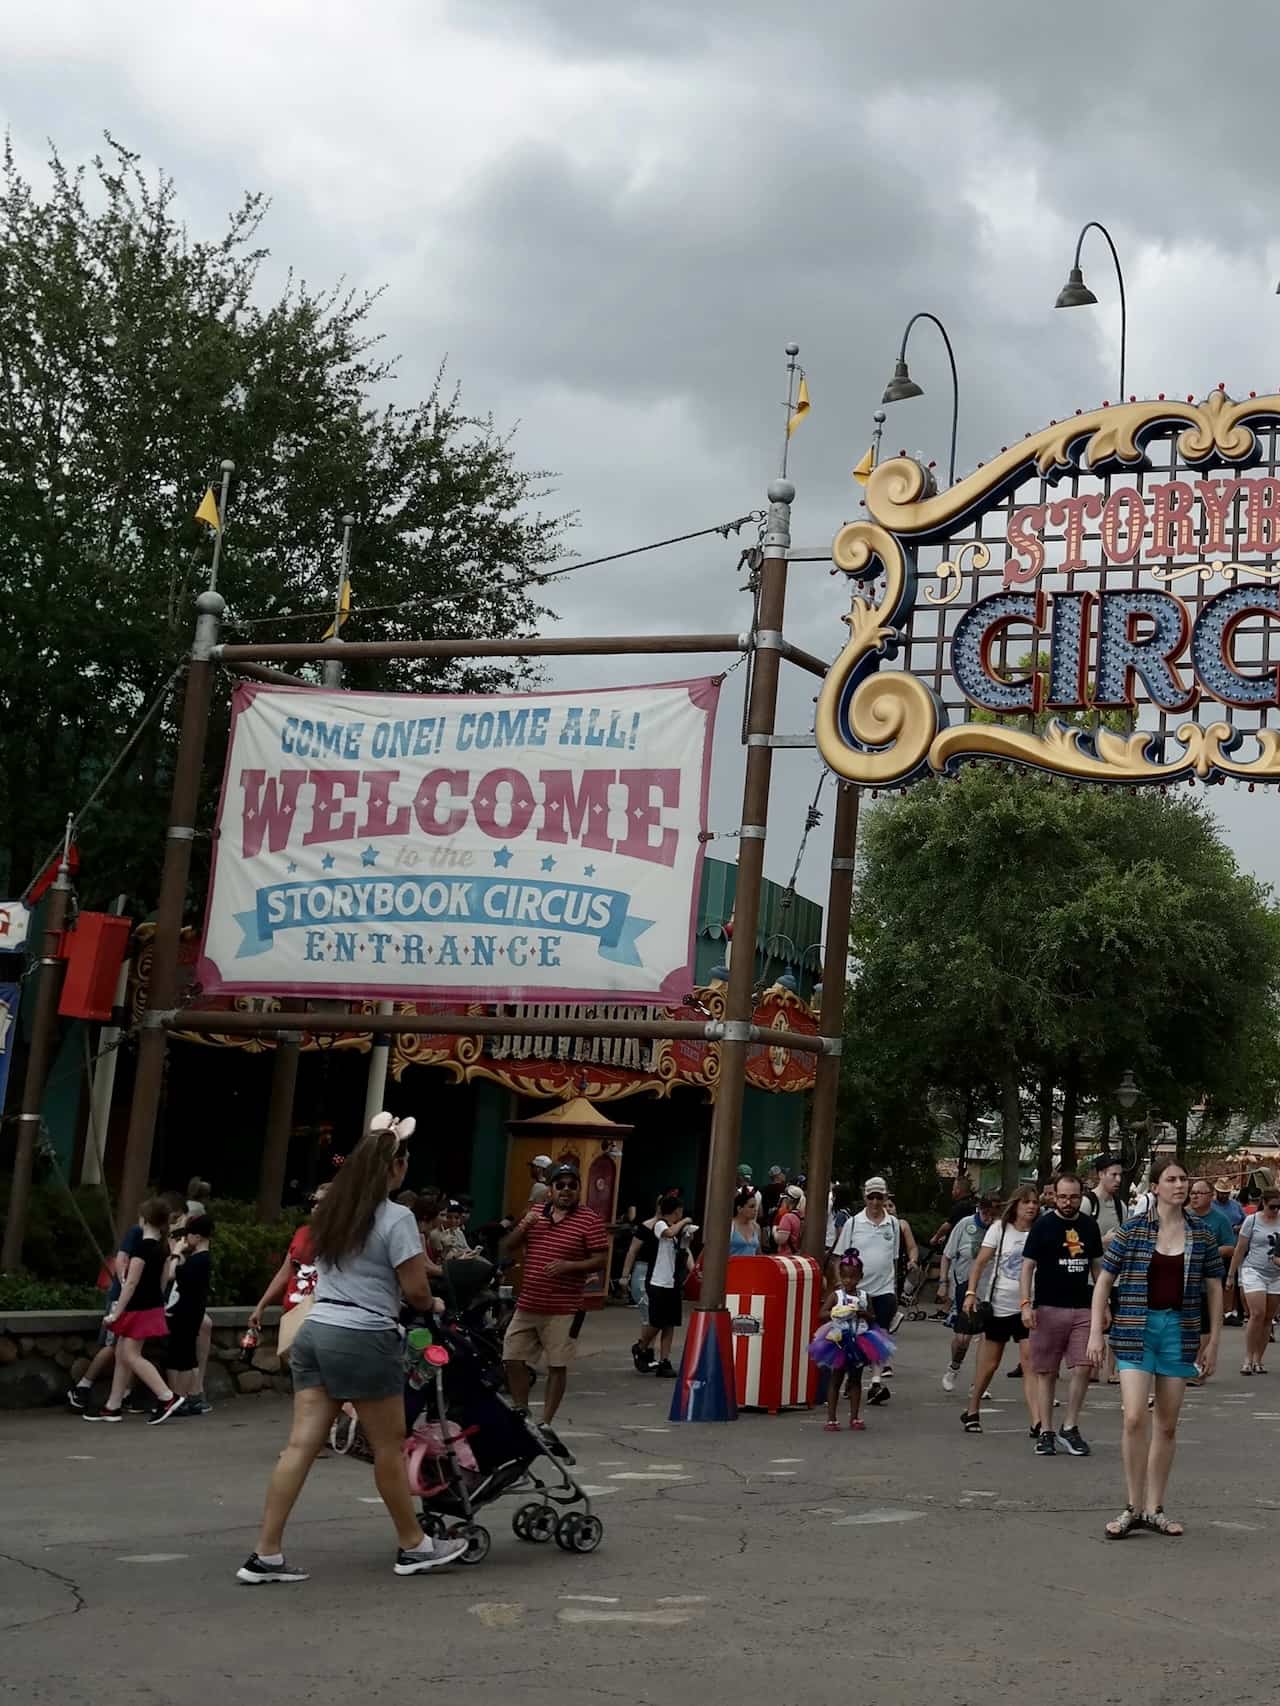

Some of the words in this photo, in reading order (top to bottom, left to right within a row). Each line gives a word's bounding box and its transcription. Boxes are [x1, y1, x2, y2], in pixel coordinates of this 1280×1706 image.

[281, 717, 365, 761] COME
[371, 717, 446, 759] ONE!
[456, 707, 552, 753] COME
[558, 707, 641, 751] ALL!
[240, 768, 682, 868] WELCOME
[396, 845, 419, 867] to
[429, 838, 475, 867] the
[267, 881, 472, 924] STORYBOOK
[483, 884, 614, 929] CIRCUS
[304, 931, 561, 967] ENTRANCE
